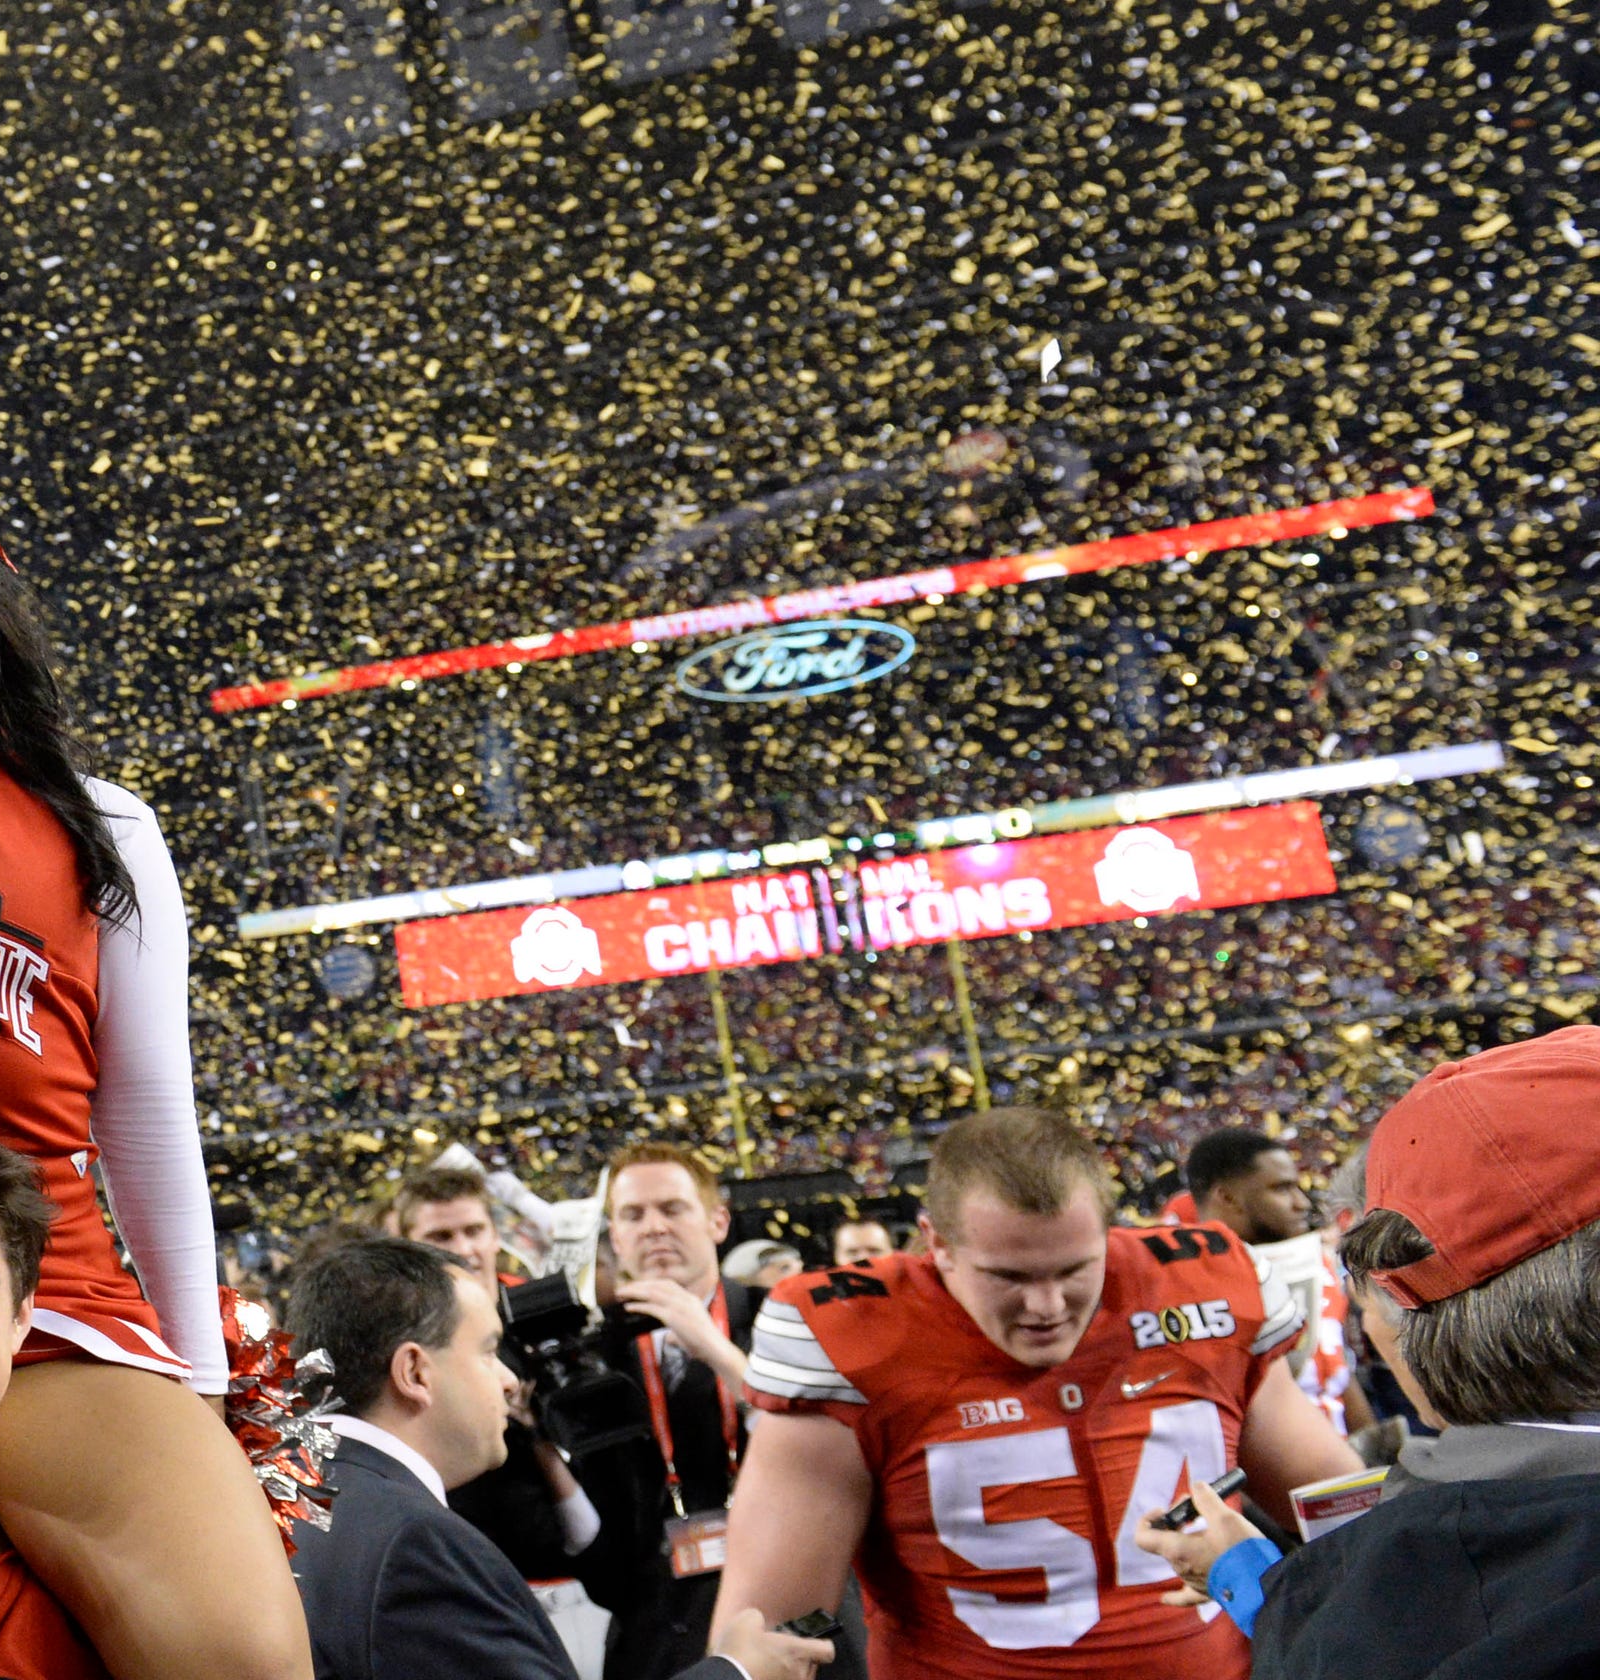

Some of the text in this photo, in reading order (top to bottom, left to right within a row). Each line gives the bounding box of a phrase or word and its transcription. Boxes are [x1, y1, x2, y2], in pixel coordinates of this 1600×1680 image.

[722, 631, 866, 692] Ford
[1129, 1299, 1237, 1350] 2015
[925, 1399, 1228, 1650] 54
